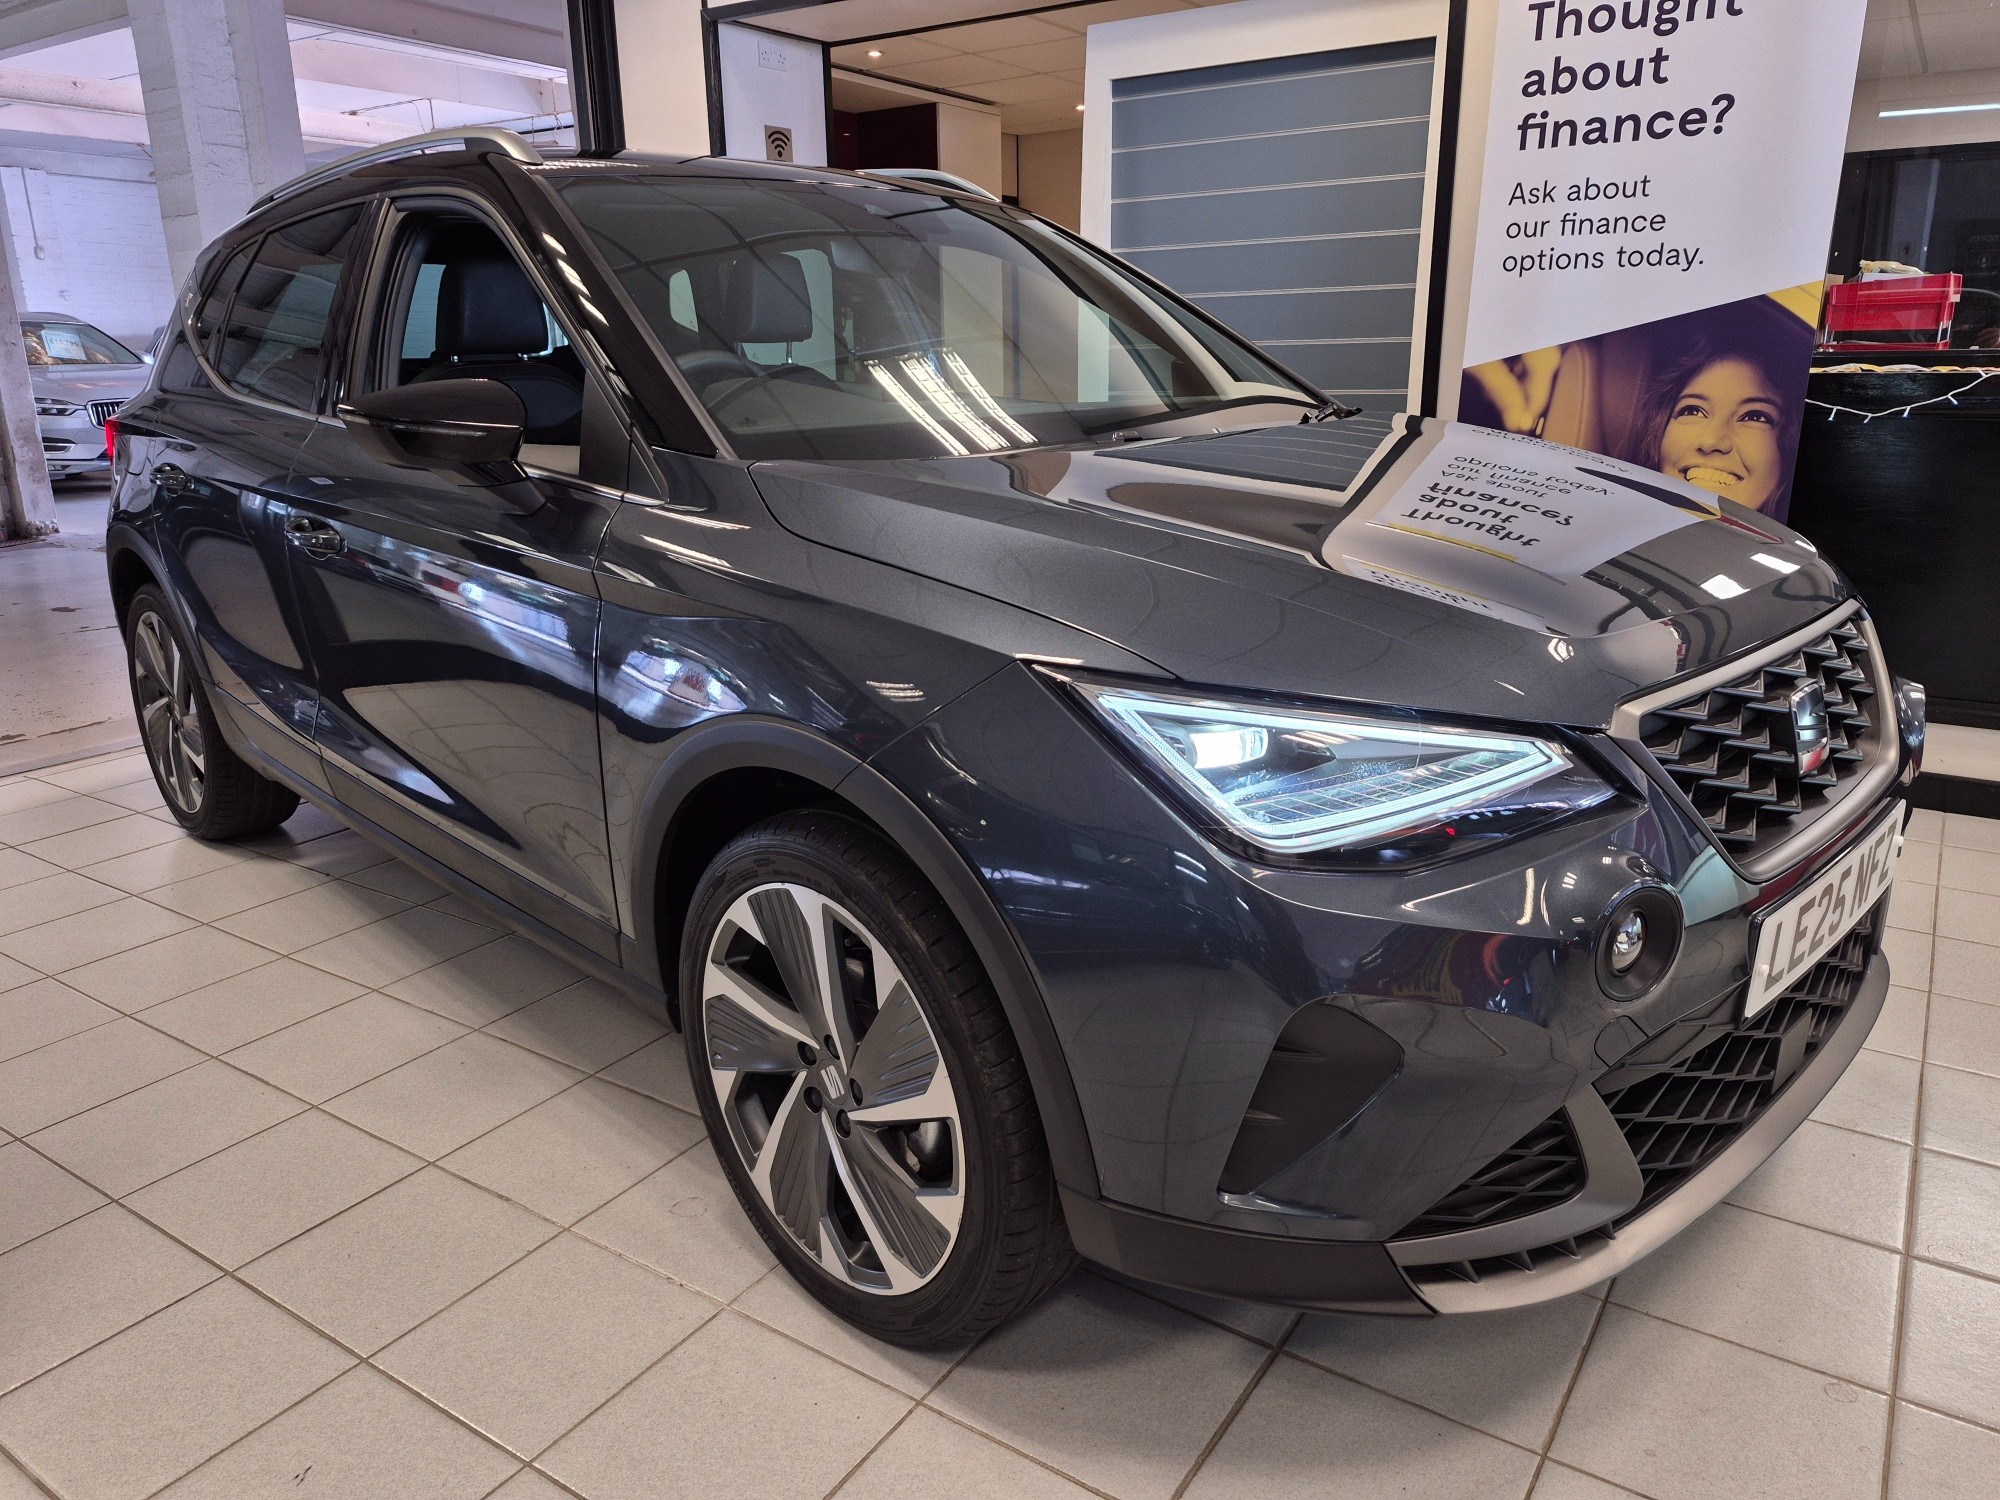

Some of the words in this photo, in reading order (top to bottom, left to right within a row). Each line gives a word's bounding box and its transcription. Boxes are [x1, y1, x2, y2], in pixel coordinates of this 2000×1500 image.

[1521, 47, 1670, 98] about
[1517, 93, 1736, 151] finance?
[1508, 180, 1558, 206] Ask
[1567, 175, 1651, 202] about
[1506, 219, 1550, 239] our
[1560, 212, 1666, 237] finance
[1502, 247, 1605, 278] options
[1616, 242, 1704, 272] today.
[1763, 864, 1853, 994] LE25
[1848, 818, 1898, 919] NFZ
